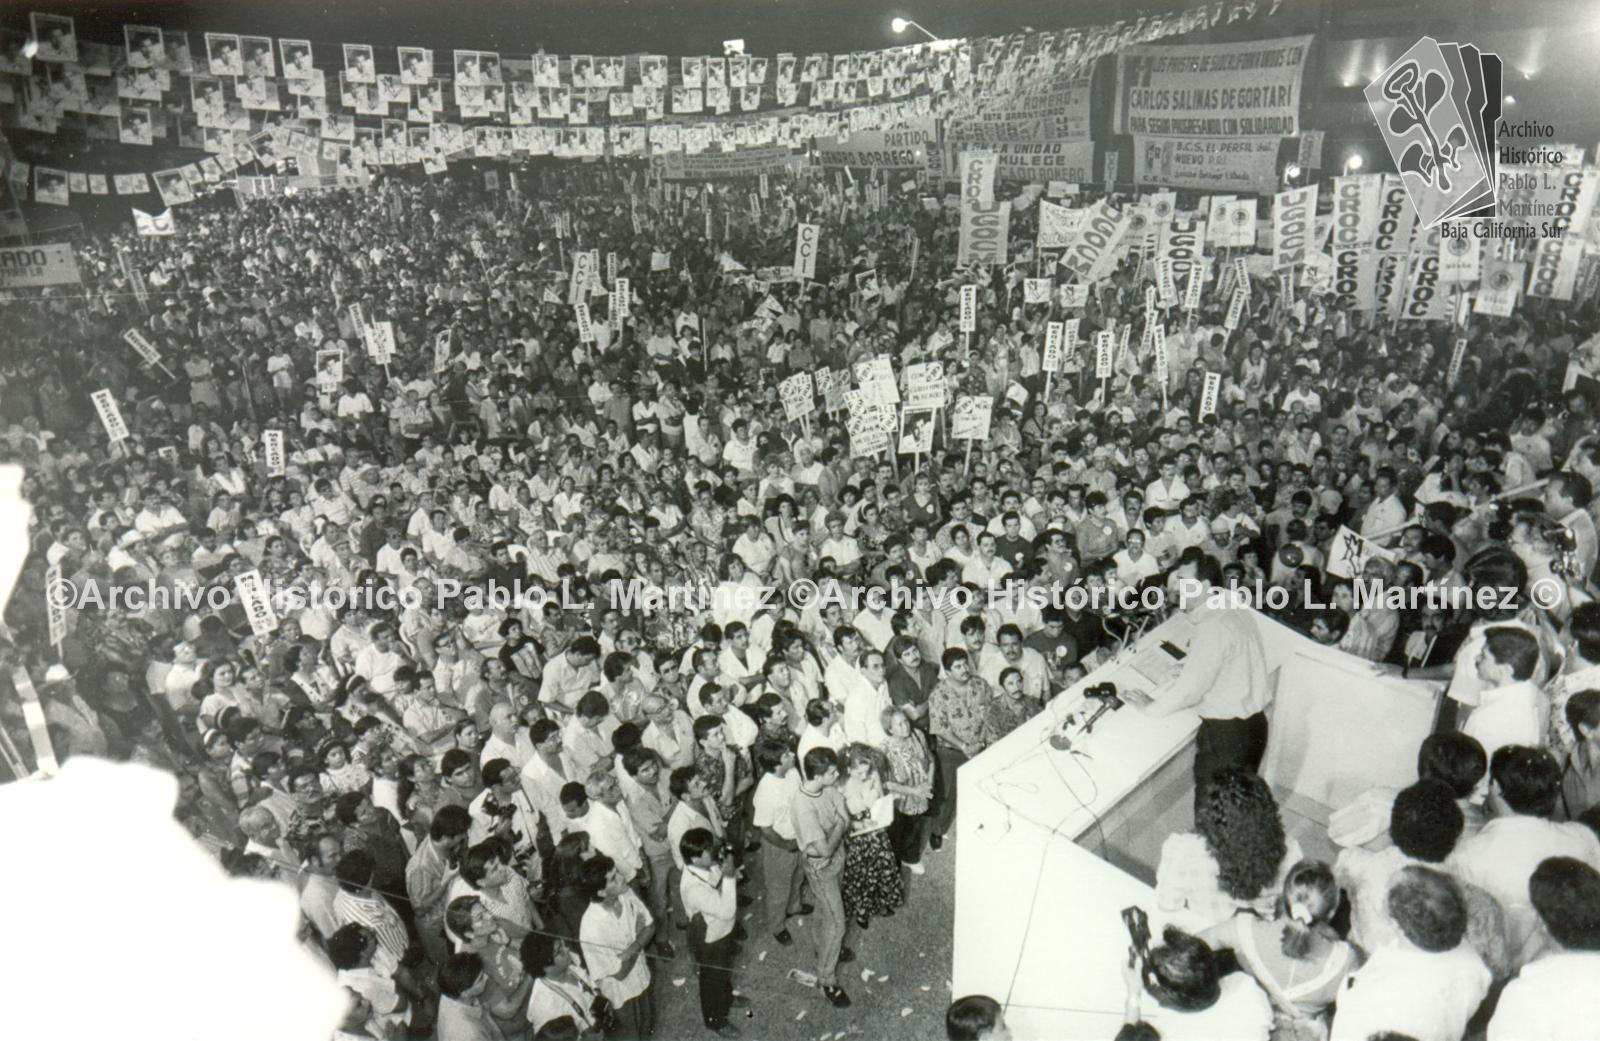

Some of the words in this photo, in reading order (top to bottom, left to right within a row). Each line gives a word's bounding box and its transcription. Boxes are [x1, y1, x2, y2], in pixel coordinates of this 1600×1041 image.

[1130, 88, 1169, 110] CARLOS
[1172, 88, 1218, 111] SALINAS
[1221, 87, 1234, 110] DE
[1237, 84, 1292, 109] GORTARI
[884, 130, 929, 147] PARTIDO
[1239, 116, 1293, 134] SOLIDARIDAD
[992, 143, 1005, 154] LA
[1014, 143, 1062, 155] UNIDAD
[999, 155, 1066, 166] MULEGE
[1175, 153, 1203, 165] NUEVO
[1220, 142, 1253, 152] PERFIL
[966, 159, 983, 204] CRO
[1039, 167, 1085, 182] ROMERO
[1338, 184, 1361, 243] CROC
[1375, 188, 1406, 250] CROC
[1554, 172, 1583, 230] CROC
[1279, 191, 1307, 265] UGOCM
[801, 226, 814, 274] CCI
[1533, 240, 1564, 296] CROC
[1408, 257, 1439, 317] CROC
